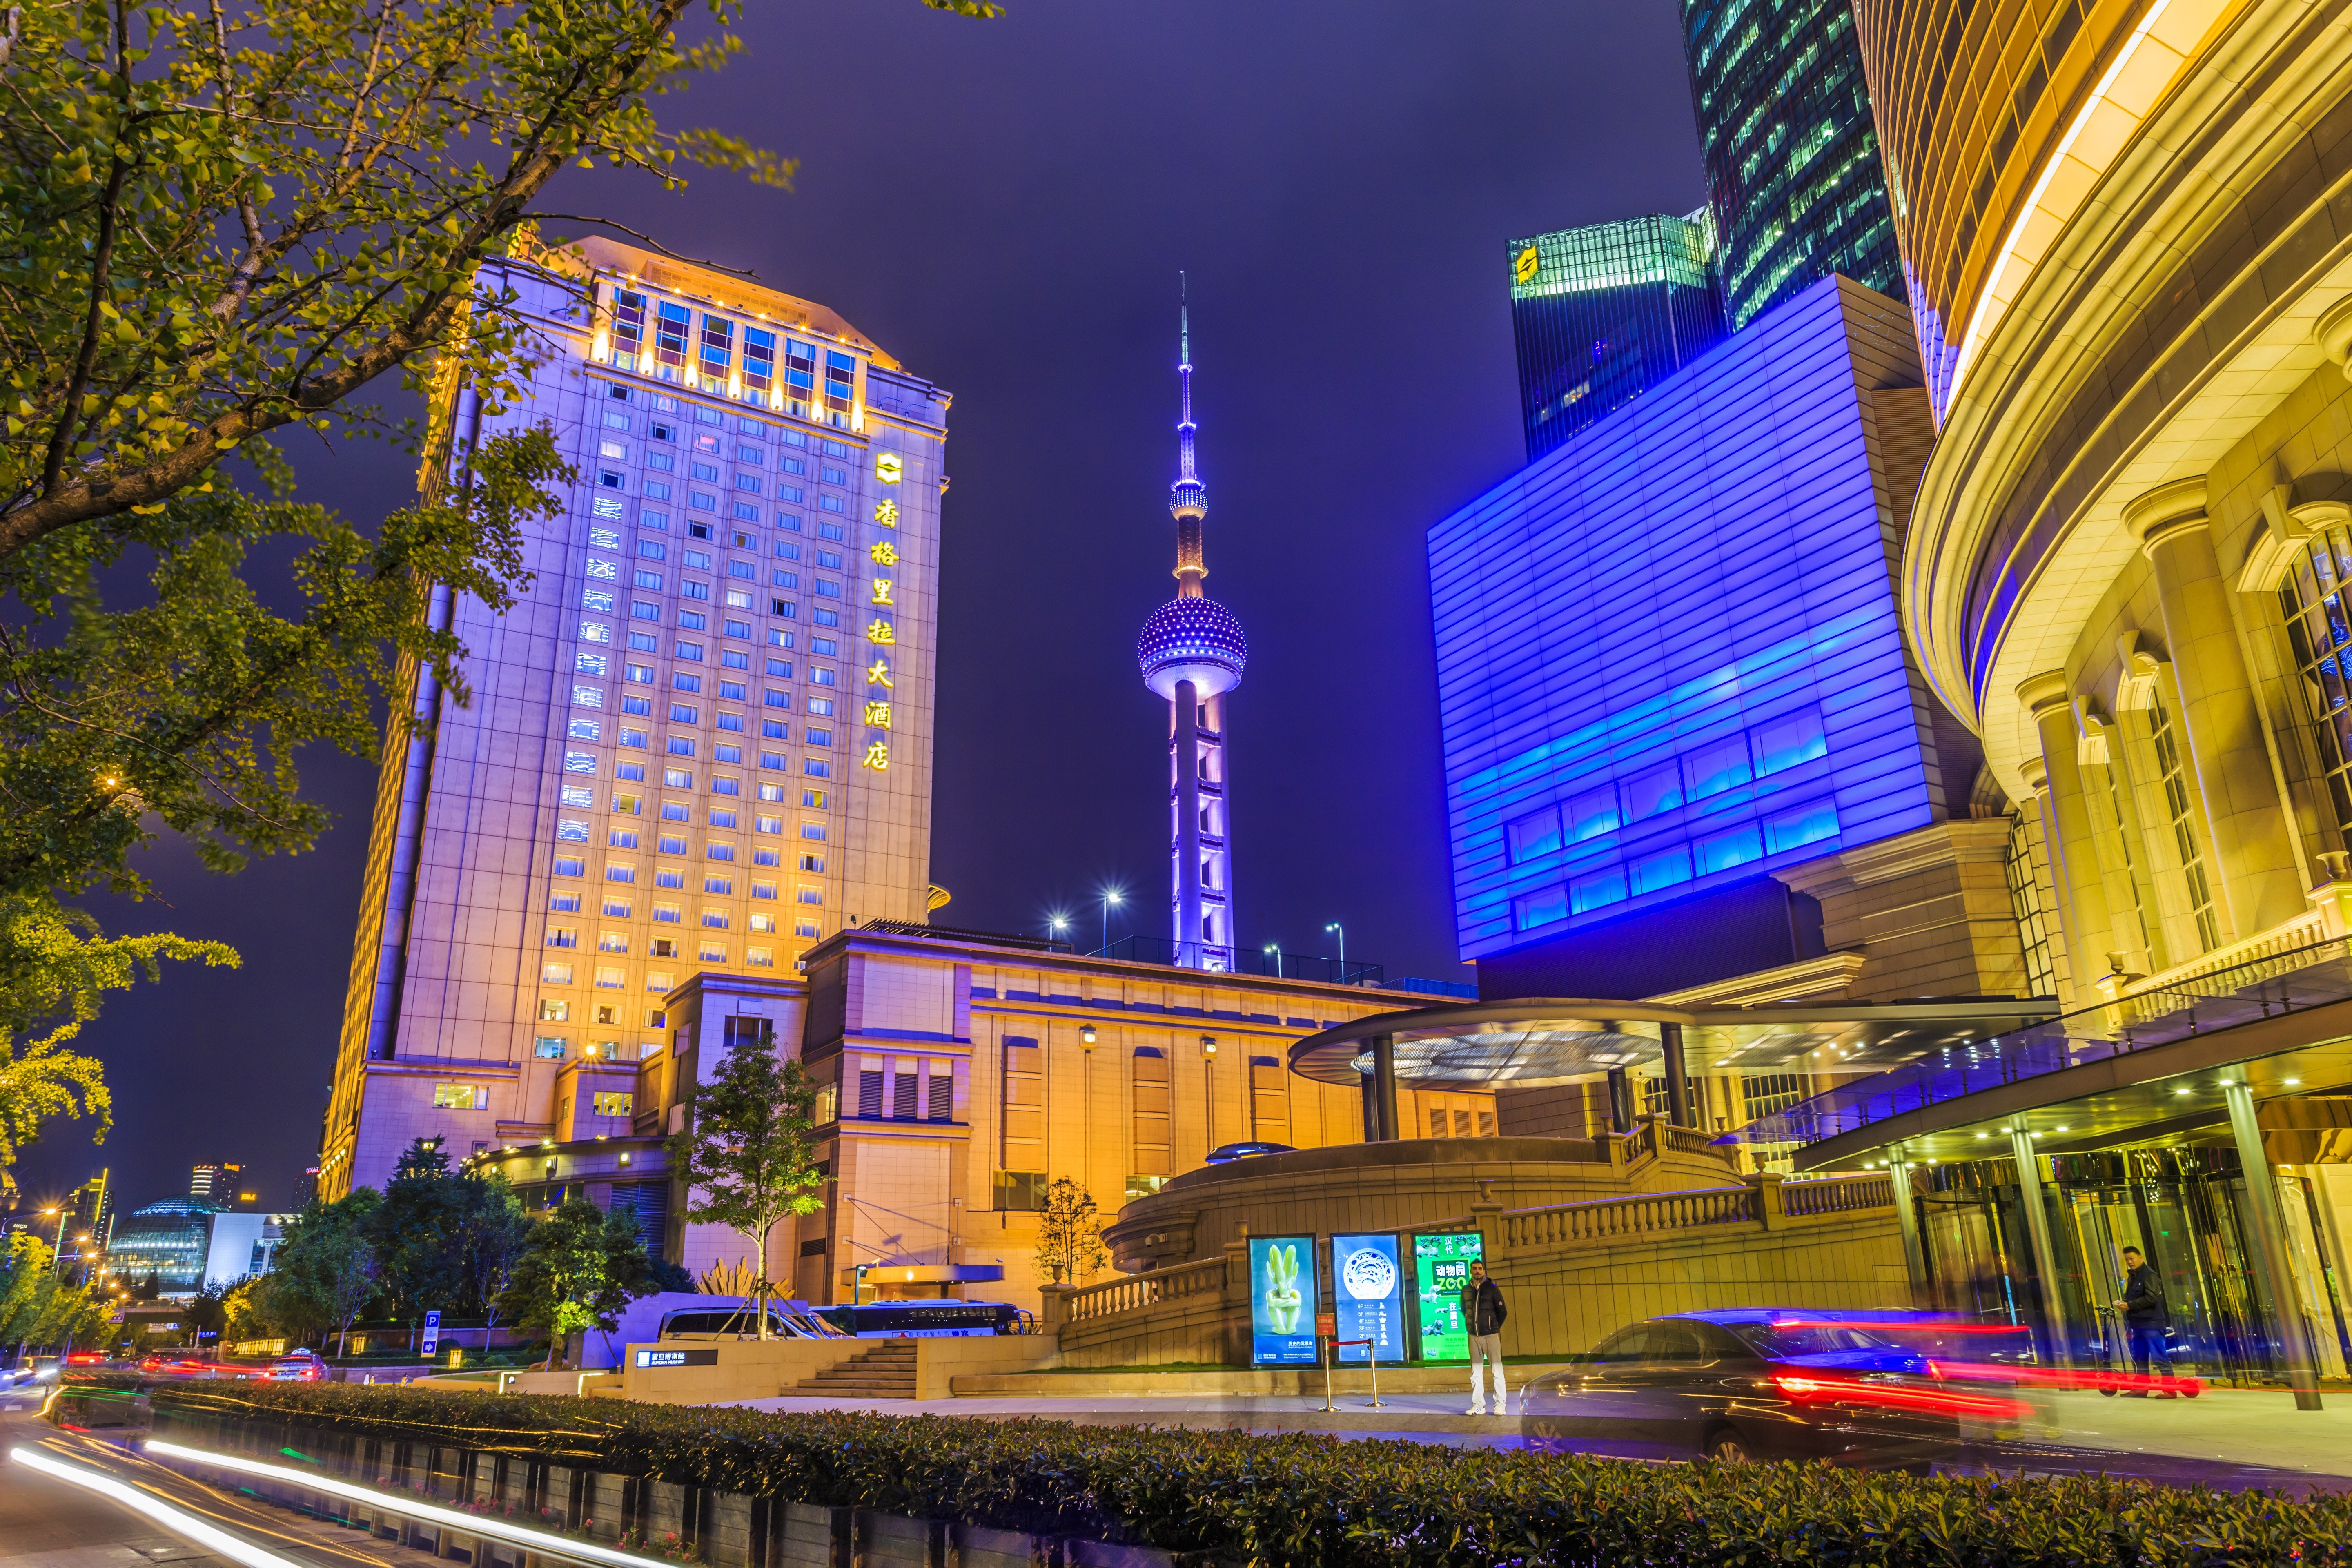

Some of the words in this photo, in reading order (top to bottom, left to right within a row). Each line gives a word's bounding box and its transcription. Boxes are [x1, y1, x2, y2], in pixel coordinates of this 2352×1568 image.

[864, 498, 899, 771] 香格里拉大酒店
[1445, 1236, 1453, 1254] 汉代
[1436, 1265, 1466, 1276] 动物园
[1437, 1277, 1467, 1290] ZOO
[429, 1316, 437, 1325] P
[1449, 1302, 1458, 1329] 在震旦
